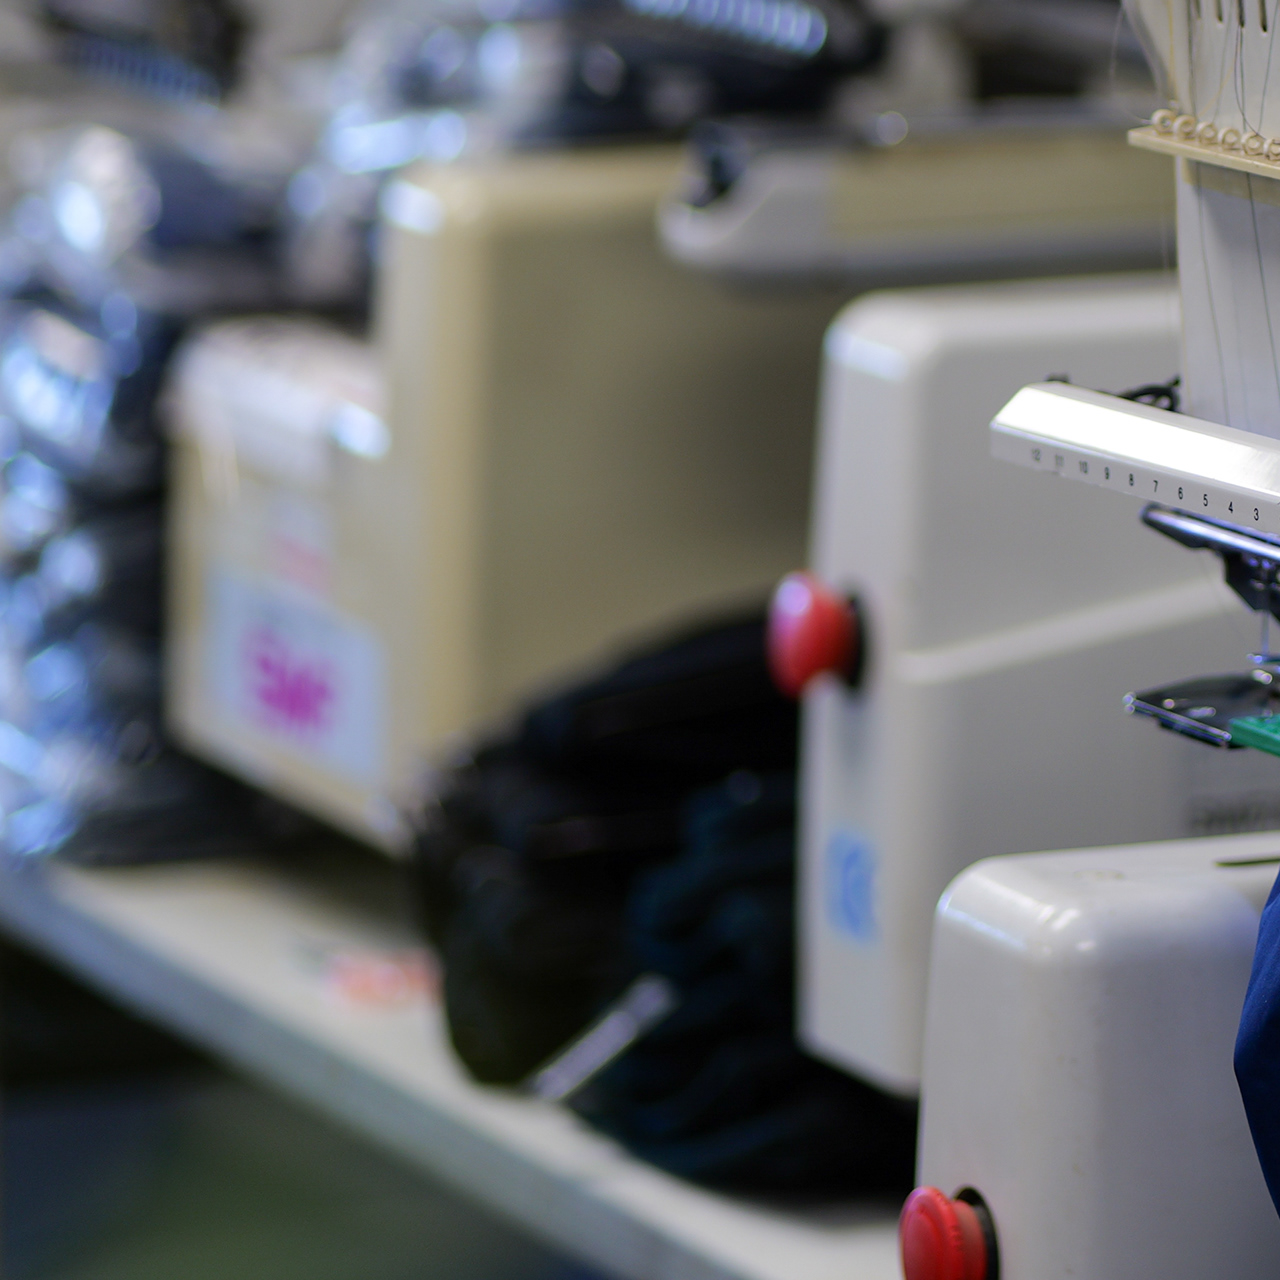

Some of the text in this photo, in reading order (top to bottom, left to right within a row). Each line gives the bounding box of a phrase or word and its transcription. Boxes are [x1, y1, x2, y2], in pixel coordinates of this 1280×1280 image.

[1079, 460, 1088, 474] 10
[1104, 466, 1110, 480] 9
[1129, 473, 1134, 486] 8
[1153, 479, 1159, 493] 7
[1178, 487, 1183, 500] 6
[1203, 493, 1208, 507] 5
[1228, 501, 1234, 514] 4
[1253, 507, 1260, 521] 3
